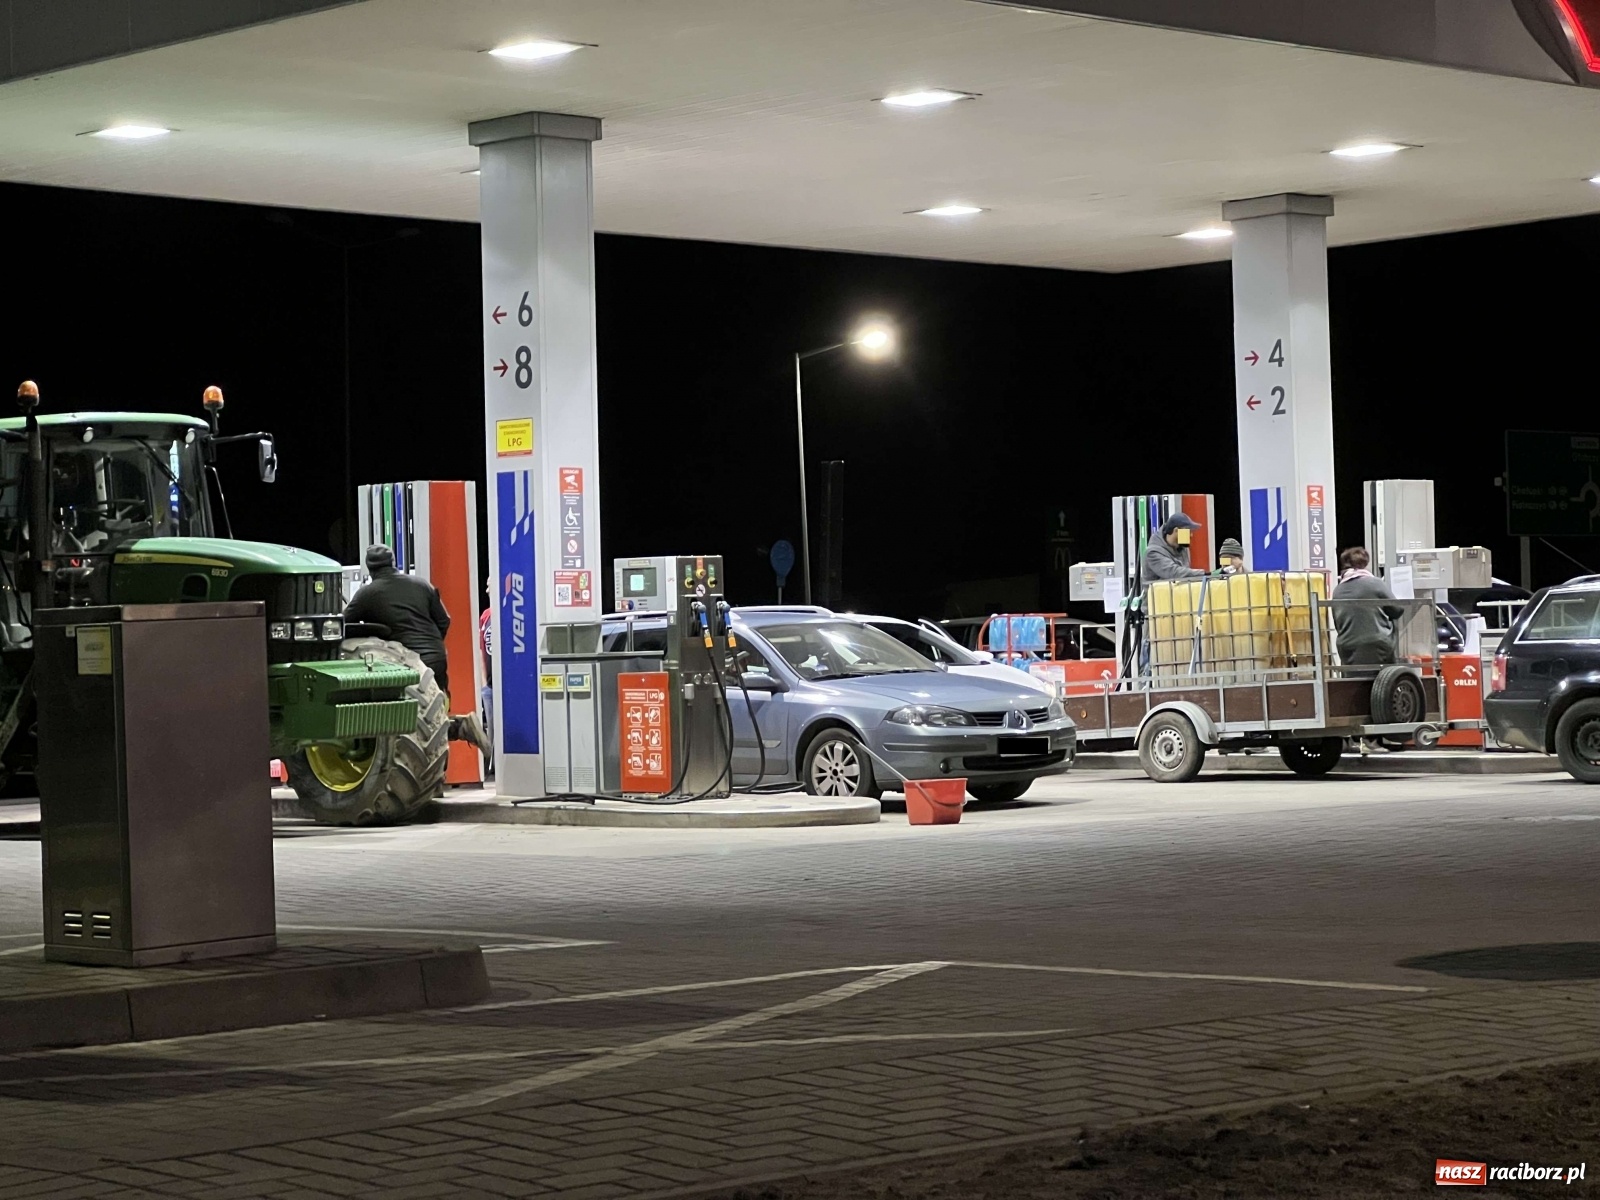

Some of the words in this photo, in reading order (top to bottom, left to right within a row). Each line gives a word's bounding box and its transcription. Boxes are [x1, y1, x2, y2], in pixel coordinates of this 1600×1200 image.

[518, 291, 533, 328] 6
[515, 345, 533, 389] 8
[1268, 338, 1285, 367] 4
[1271, 385, 1286, 416] 2
[507, 437, 523, 447] LPG
